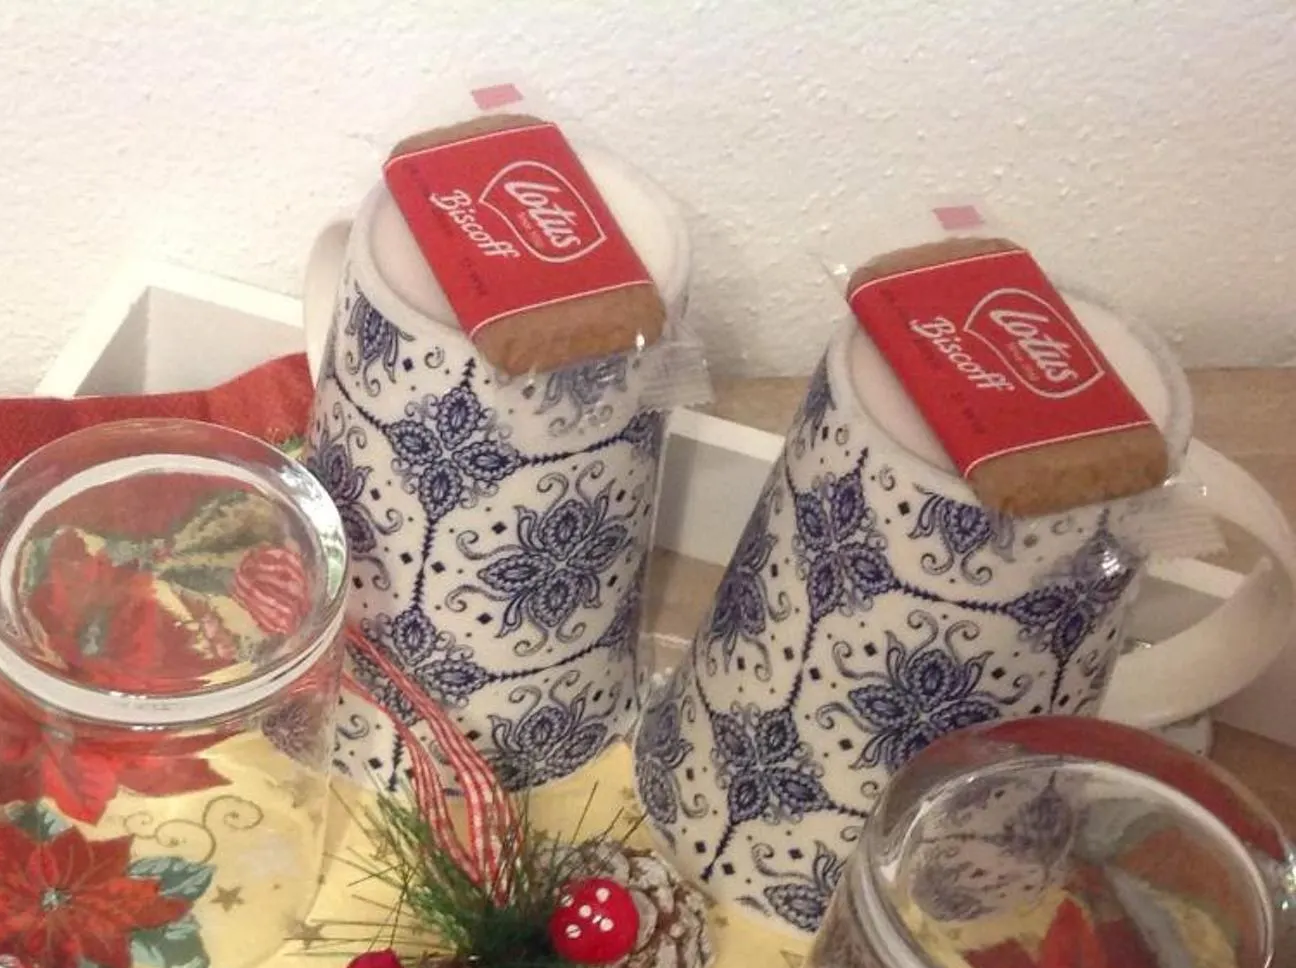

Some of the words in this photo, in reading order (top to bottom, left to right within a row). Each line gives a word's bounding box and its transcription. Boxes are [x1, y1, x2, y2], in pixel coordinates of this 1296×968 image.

[428, 189, 521, 260] Biscoff
[503, 180, 581, 249] Lotus
[908, 315, 1015, 391] Biscoff
[989, 308, 1080, 384] Lotus
